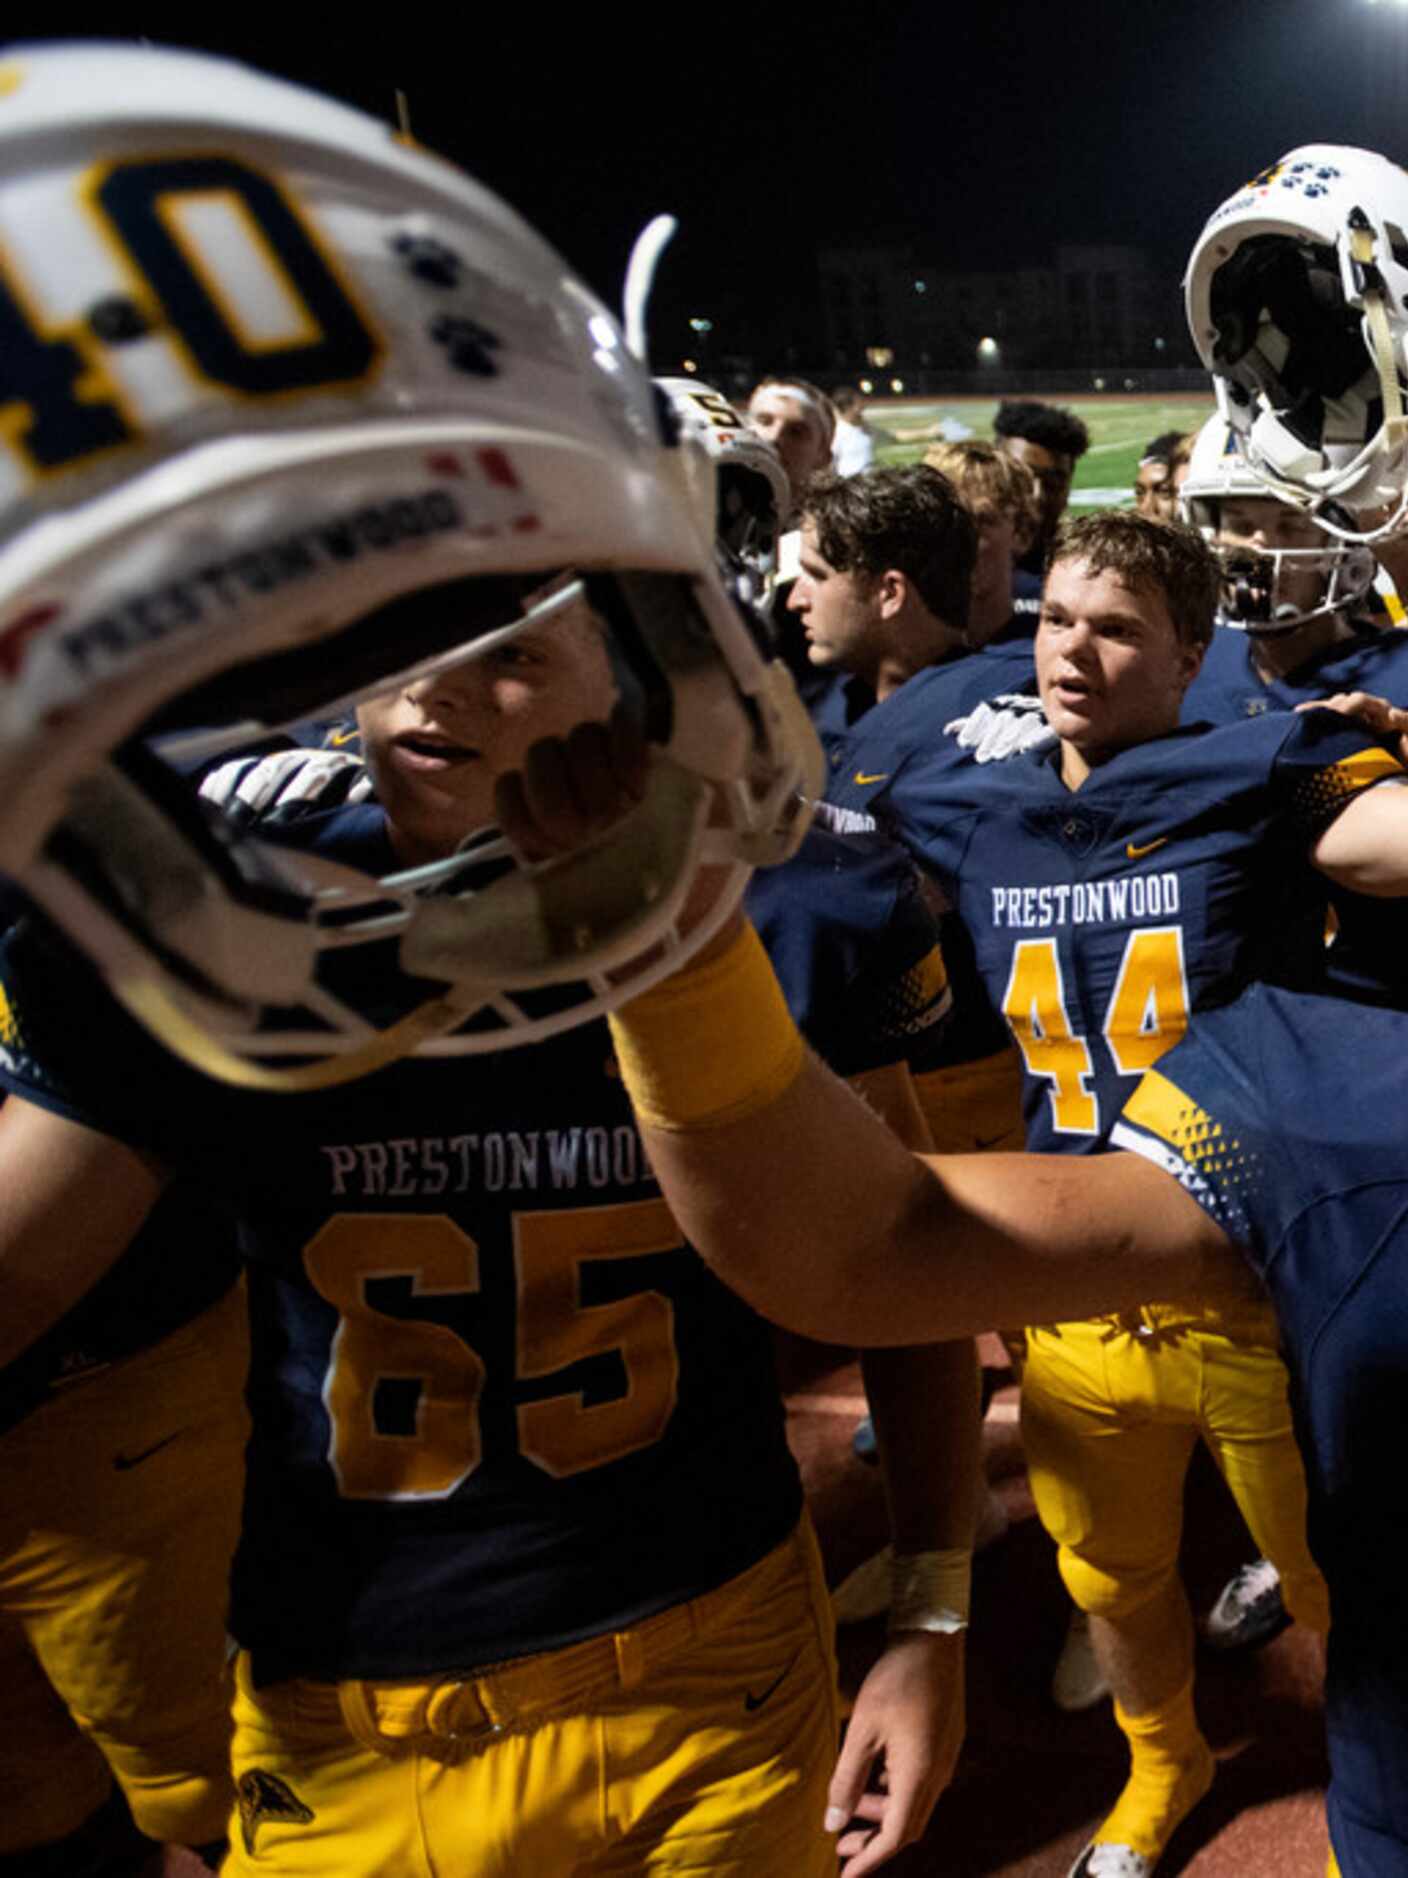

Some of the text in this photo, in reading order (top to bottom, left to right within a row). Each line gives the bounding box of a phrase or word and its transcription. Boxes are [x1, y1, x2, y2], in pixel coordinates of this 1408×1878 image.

[992, 872, 1180, 928] PRESTONWOOD
[1002, 925, 1191, 1135] 44
[302, 1197, 688, 1501] 65
